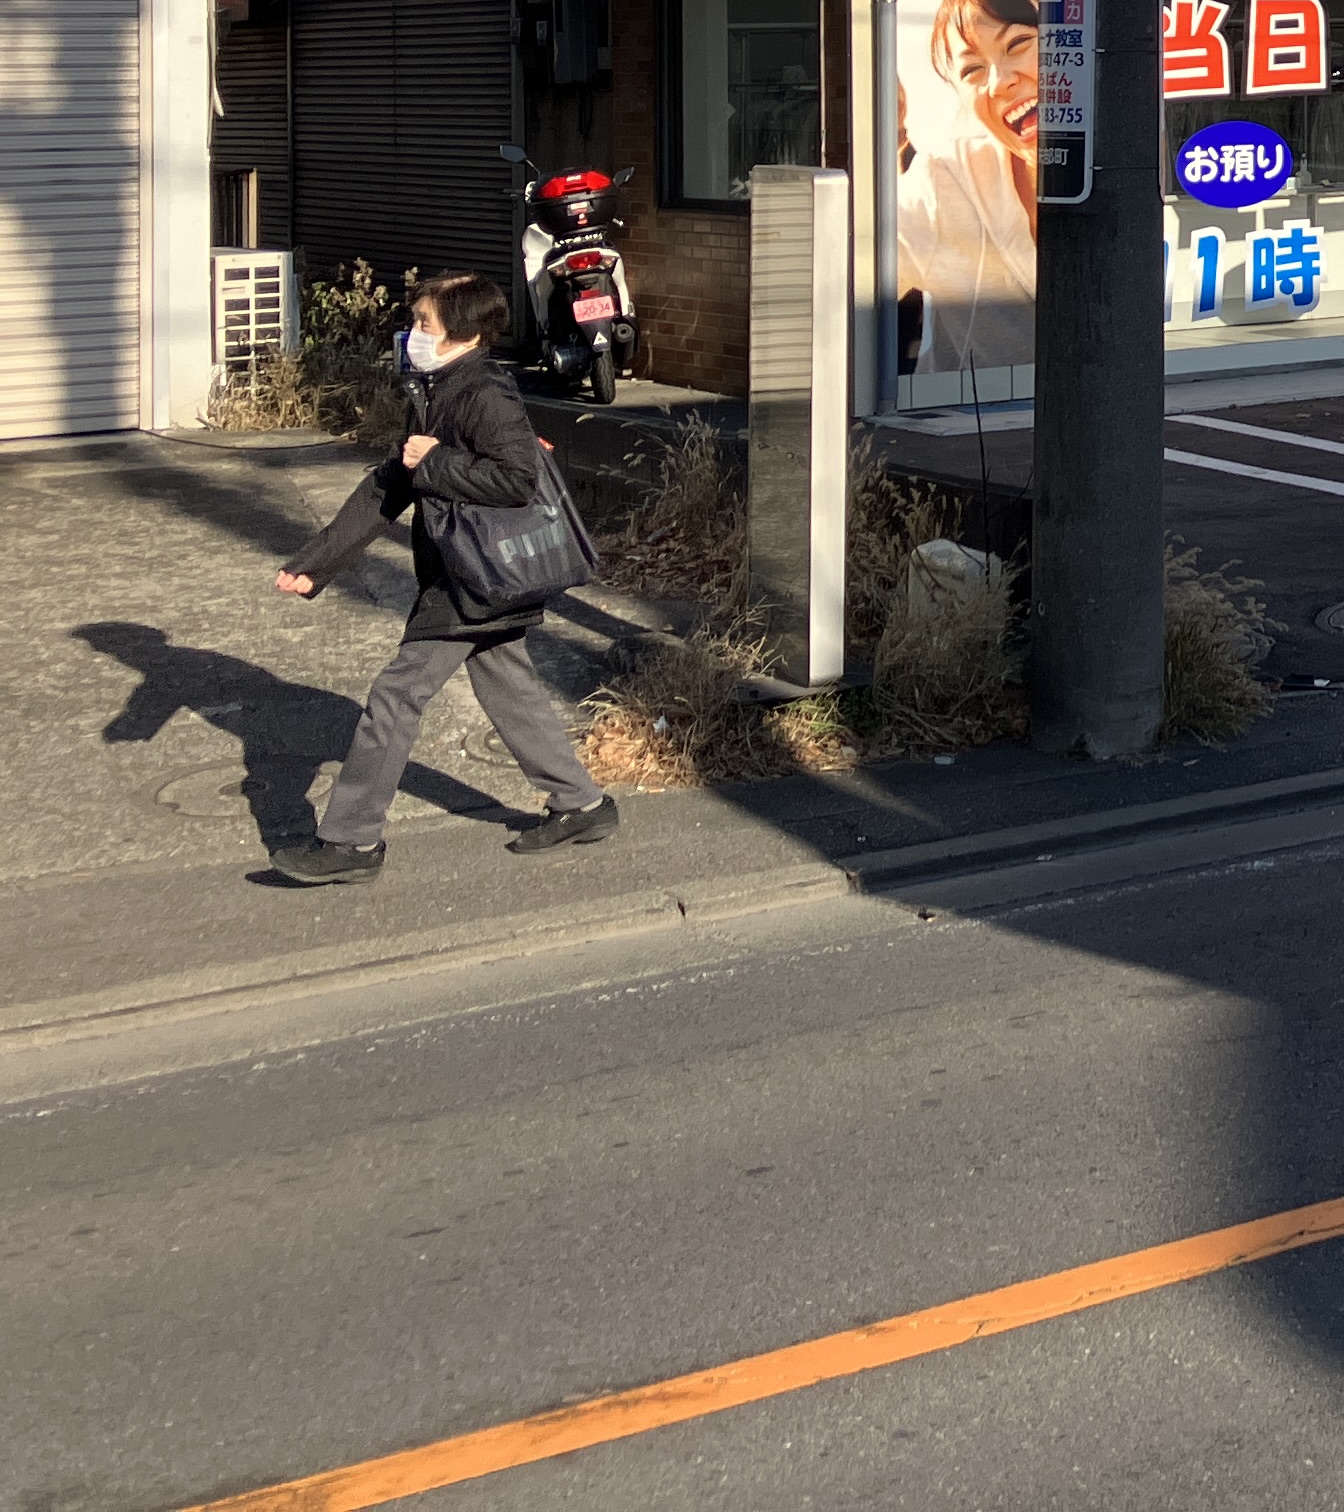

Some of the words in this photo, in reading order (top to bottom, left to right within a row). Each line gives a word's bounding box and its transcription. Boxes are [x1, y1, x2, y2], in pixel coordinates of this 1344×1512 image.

[1184, 144, 1285, 182] お預り
[1163, 219, 1329, 323] 1時
